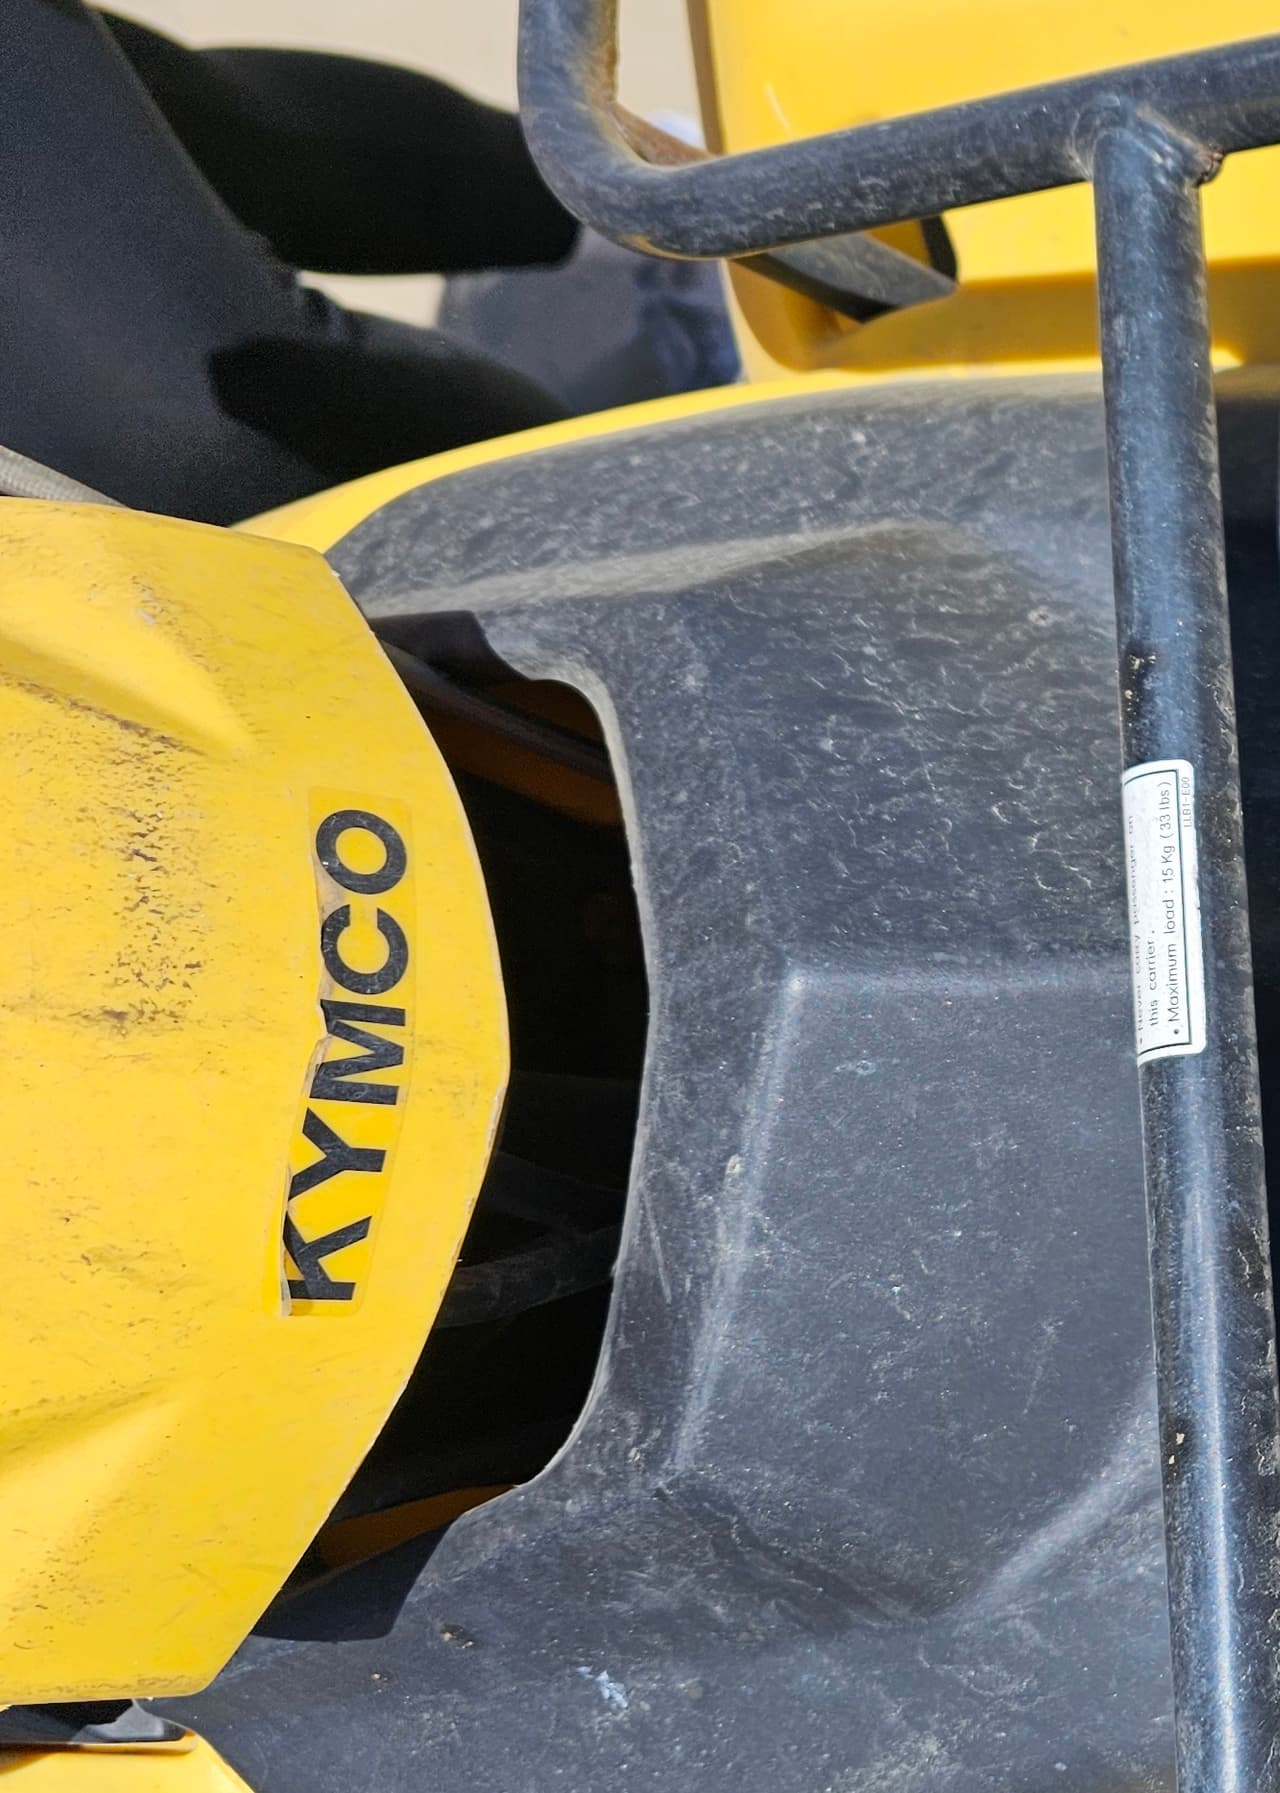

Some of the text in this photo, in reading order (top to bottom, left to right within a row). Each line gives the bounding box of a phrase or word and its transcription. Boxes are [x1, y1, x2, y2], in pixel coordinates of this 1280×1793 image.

[1160, 845, 1176, 864] Kg
[1161, 867, 1174, 882] 15
[1166, 943, 1181, 1022] Maximum
[1148, 1000, 1159, 1027] this
[281, 808, 409, 1301] KYMCO
